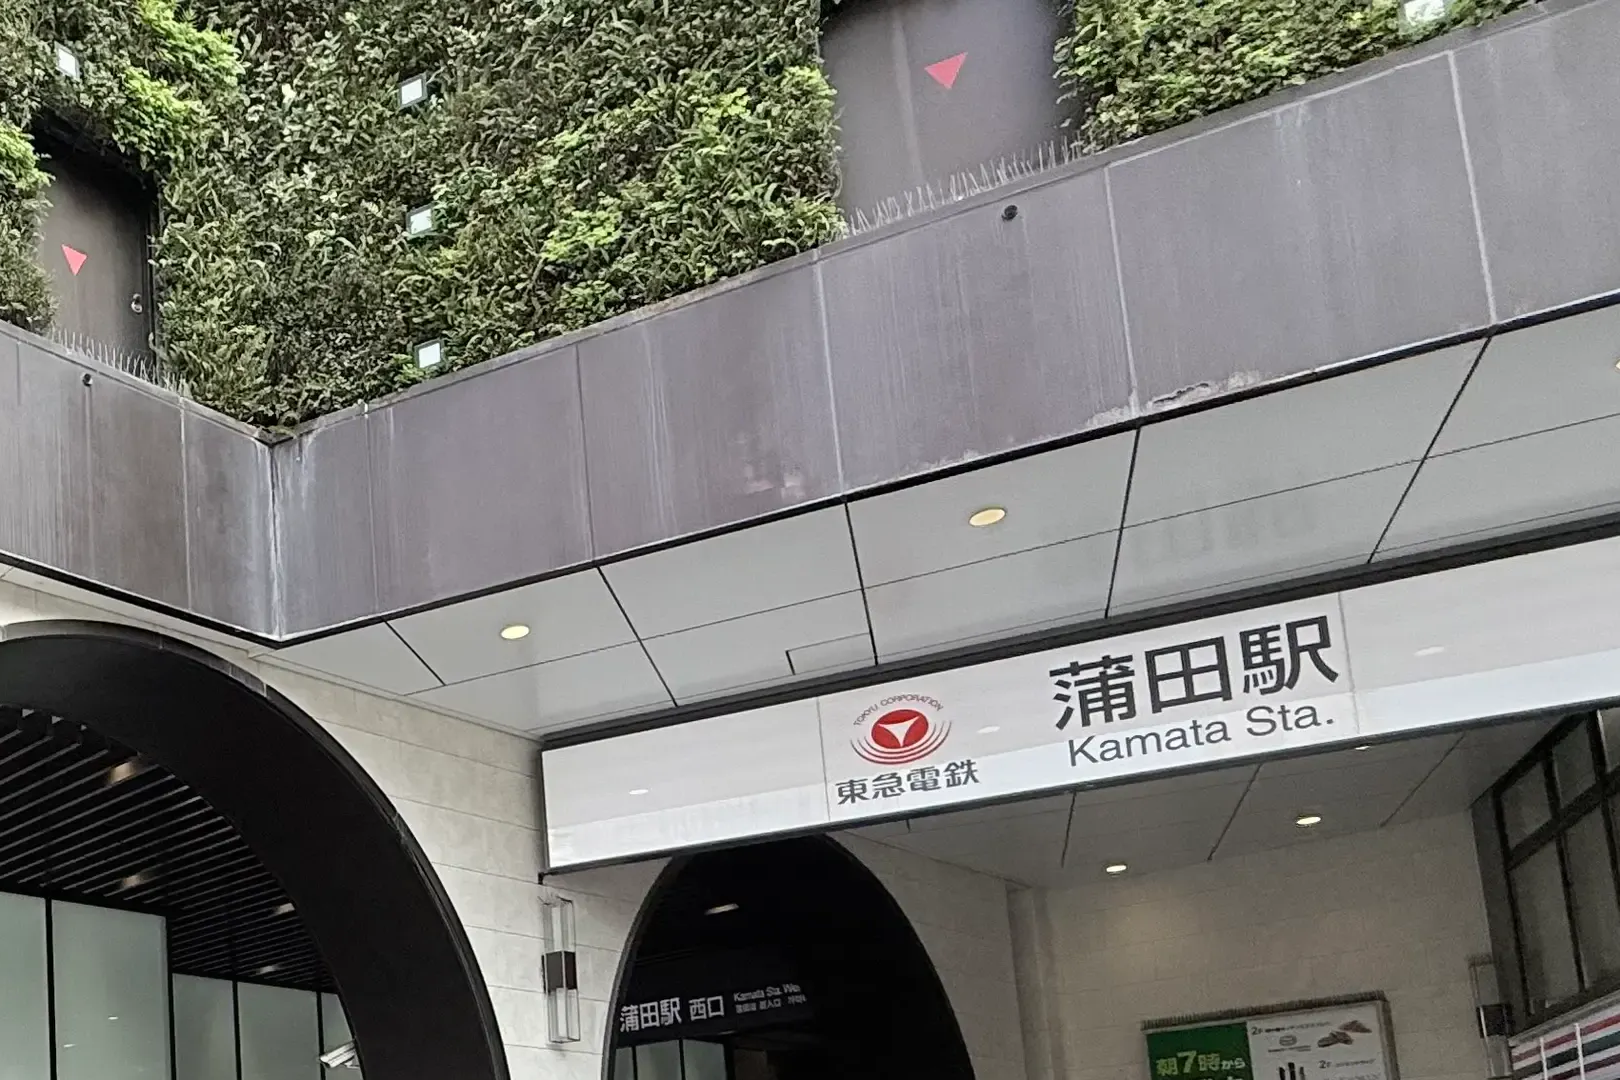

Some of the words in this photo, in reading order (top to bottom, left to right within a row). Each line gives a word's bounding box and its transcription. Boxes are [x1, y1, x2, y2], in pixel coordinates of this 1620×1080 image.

[1049, 615, 1339, 730] 蒲田駅
[853, 703, 878, 726] TOKYU
[880, 693, 944, 712] CORPORATION
[1068, 718, 1232, 767] Kamata
[1246, 704, 1335, 737] Sta.
[835, 759, 980, 806] 東急電鉄
[619, 997, 682, 1033] 蒲田駅
[688, 995, 725, 1022] 西口
[1155, 1050, 1246, 1076] 朝7時から
